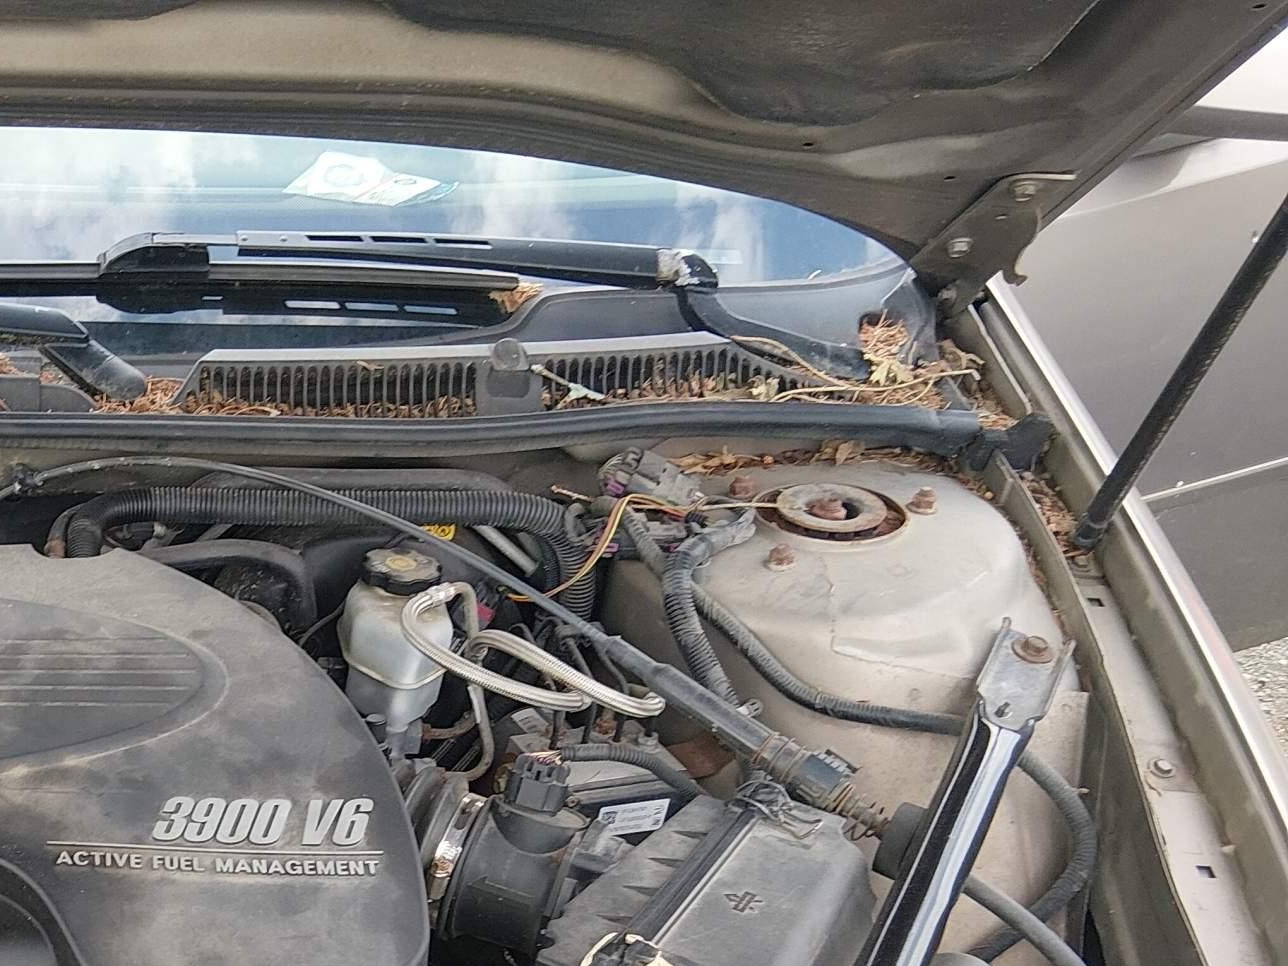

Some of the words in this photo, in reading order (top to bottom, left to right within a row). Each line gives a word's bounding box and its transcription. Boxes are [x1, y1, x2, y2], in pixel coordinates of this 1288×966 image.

[151, 796, 291, 844] 3900
[301, 797, 373, 846] V6
[55, 850, 144, 869] ACTIVE
[152, 855, 204, 873] FUEL
[215, 858, 380, 876] MANAGEMENT
